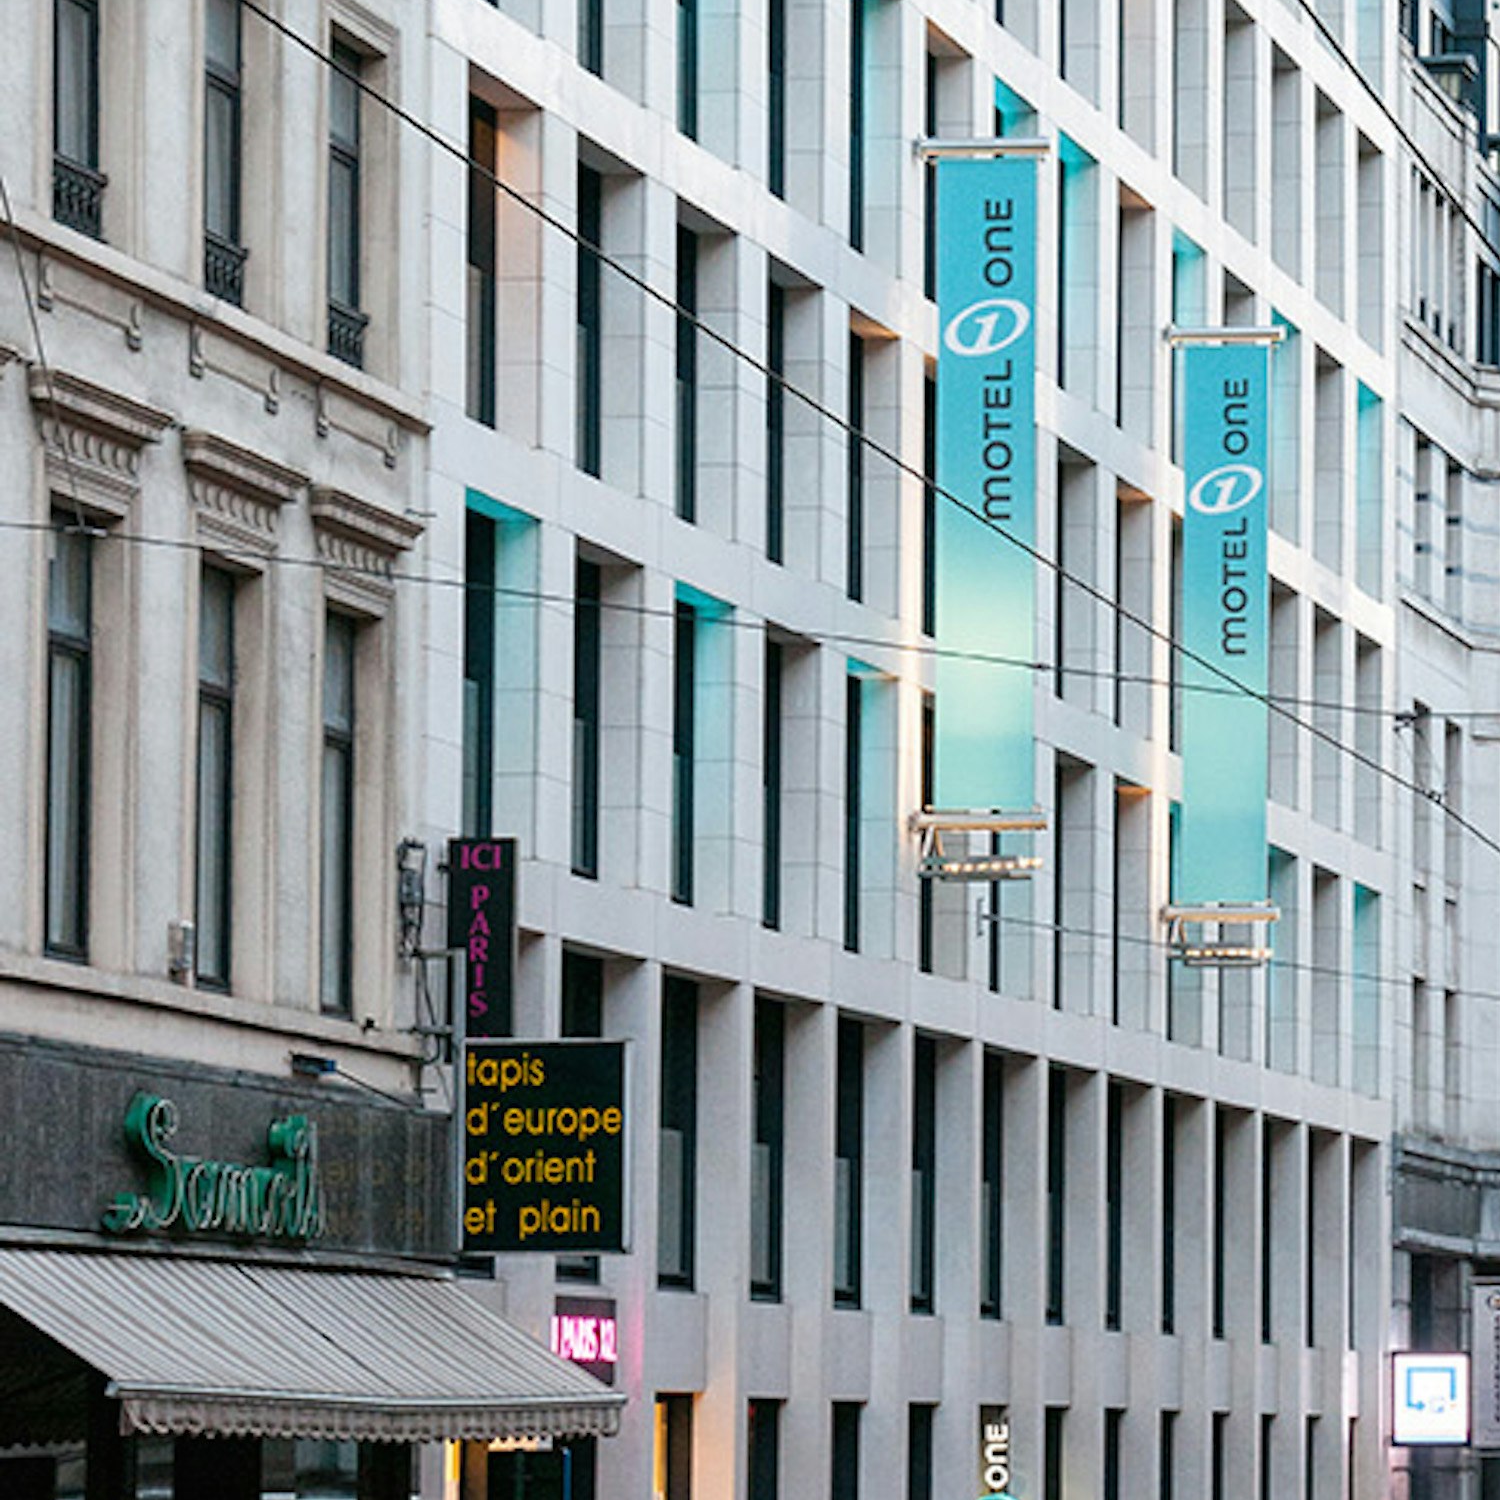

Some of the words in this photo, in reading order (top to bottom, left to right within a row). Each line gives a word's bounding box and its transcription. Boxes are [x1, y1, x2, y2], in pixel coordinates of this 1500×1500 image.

[983, 198, 1013, 287] ONE
[983, 360, 1012, 519] MOTEL
[1223, 378, 1248, 455] ONE
[1221, 517, 1247, 655] MOTEL
[460, 843, 501, 871] ICI
[468, 884, 491, 1018] PARIS
[466, 1051, 545, 1092] tapis
[464, 1198, 497, 1235] et
[519, 1198, 600, 1241] plain
[983, 1424, 1009, 1490] ONE
